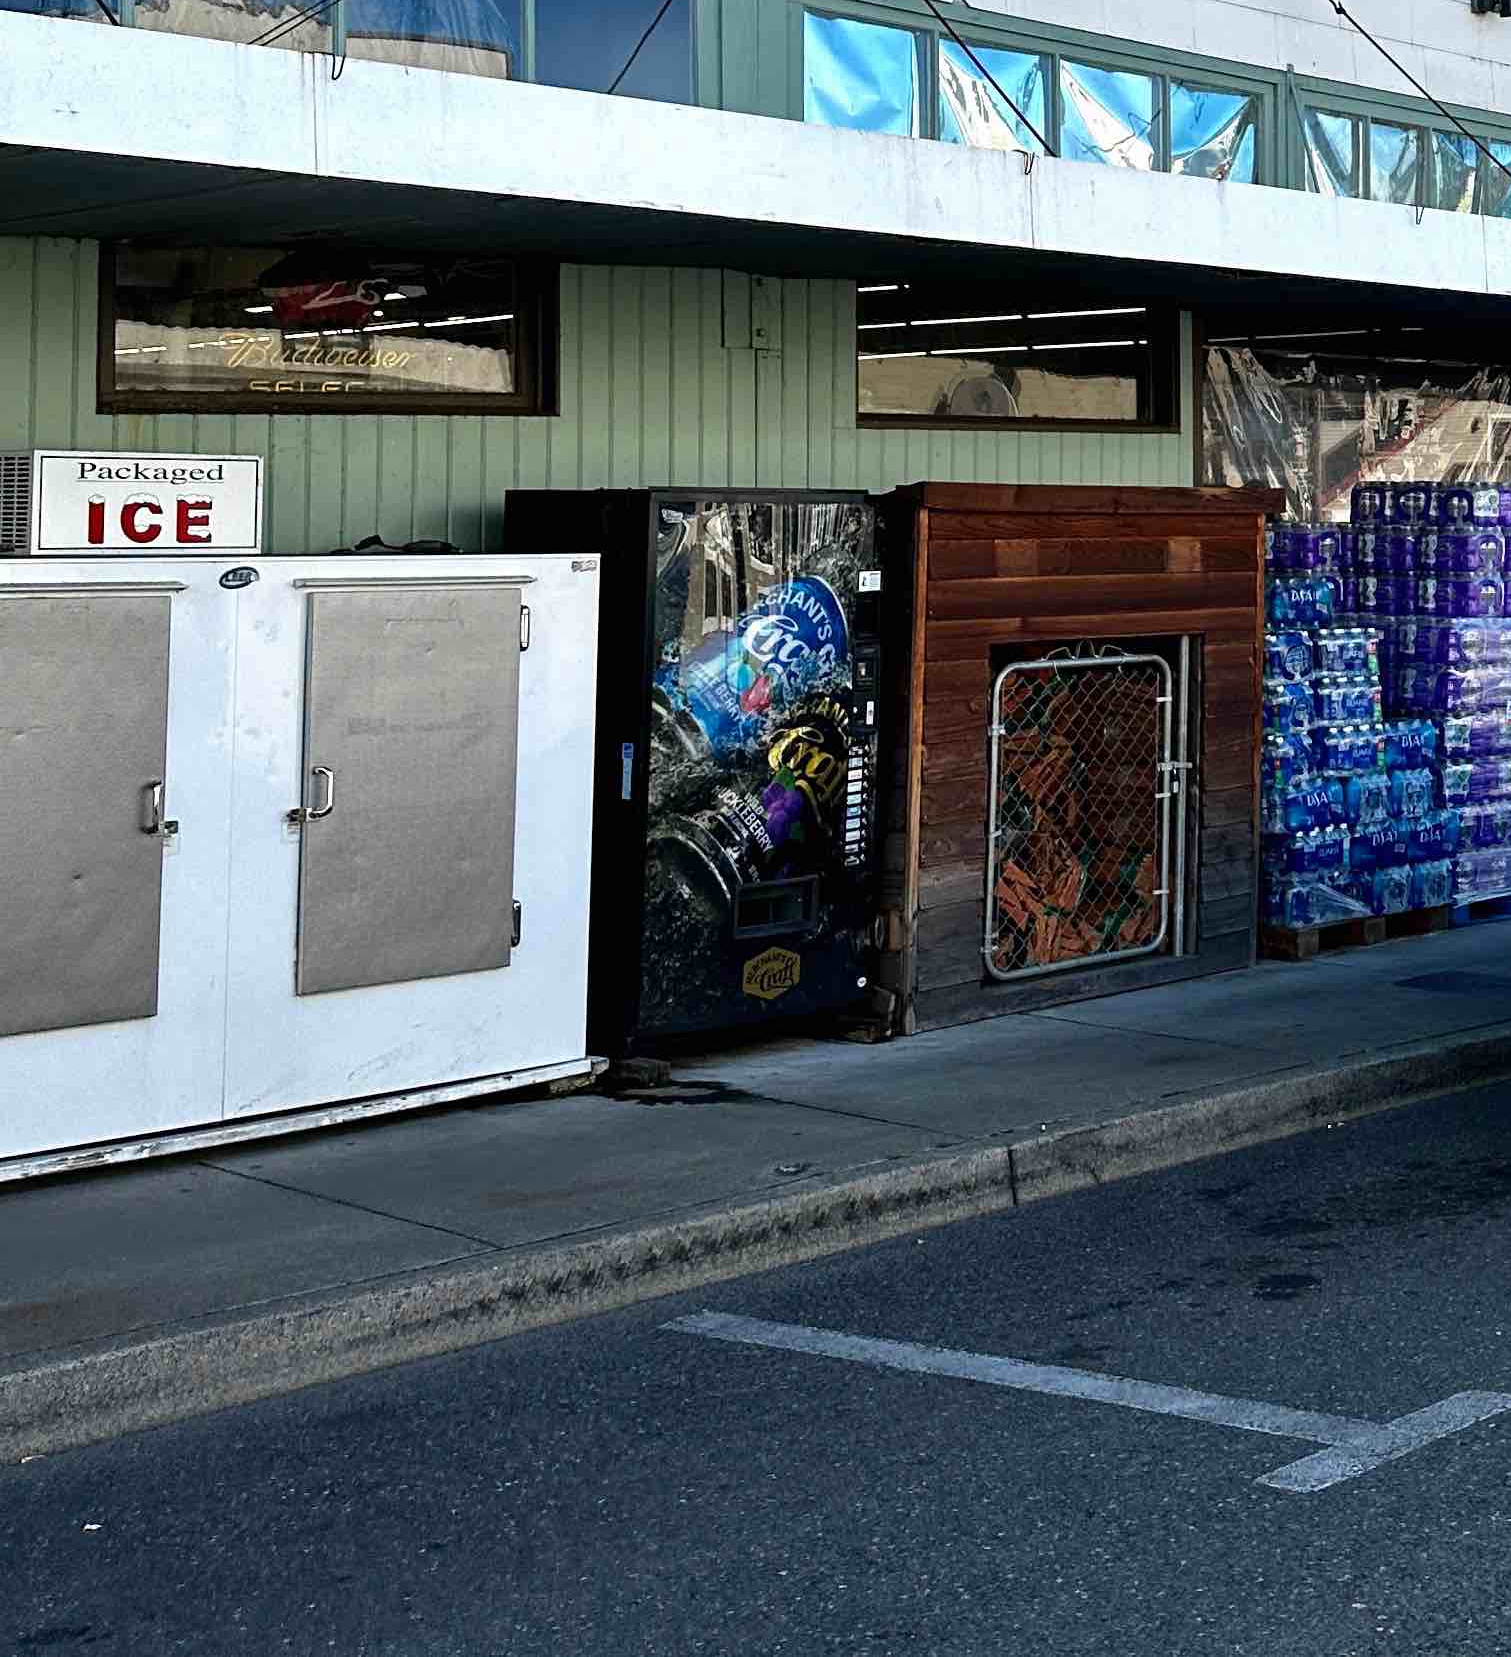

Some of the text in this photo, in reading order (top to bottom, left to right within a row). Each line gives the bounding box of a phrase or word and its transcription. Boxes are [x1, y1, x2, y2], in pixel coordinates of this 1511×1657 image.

[220, 331, 417, 368] Budweiser
[77, 461, 225, 485] Packaged
[87, 493, 214, 545] ICE
[711, 784, 775, 854] HUCKLEBERRY
